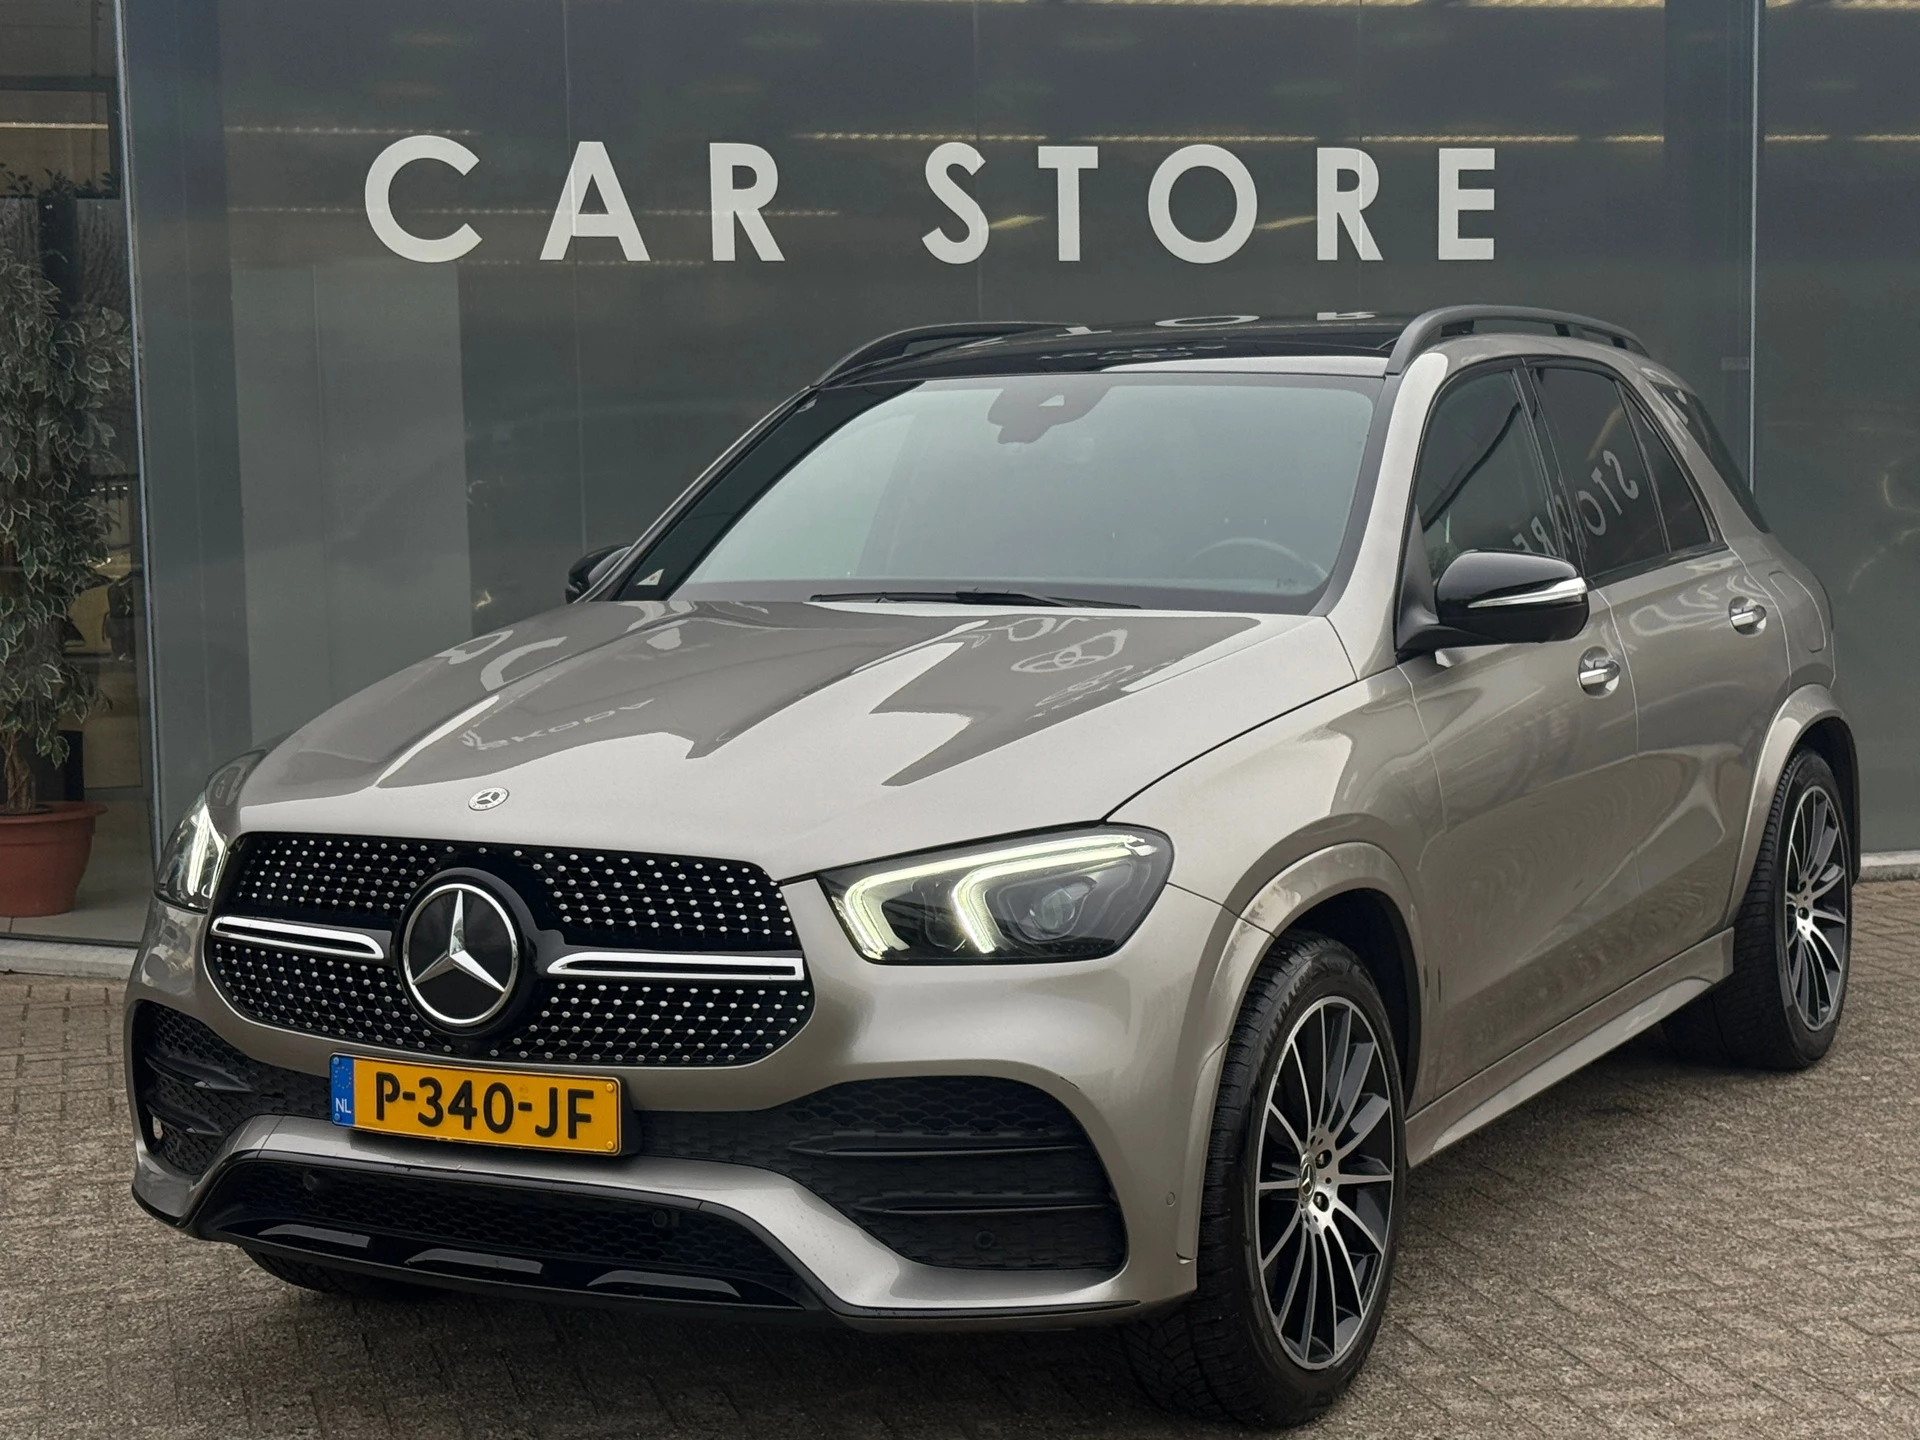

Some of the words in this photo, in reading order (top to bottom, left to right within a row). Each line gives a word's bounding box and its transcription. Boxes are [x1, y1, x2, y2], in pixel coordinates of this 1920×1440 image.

[364, 134, 785, 263] CAR
[921, 141, 1496, 264] STORE
[335, 1098, 352, 1114] NL
[375, 1071, 595, 1140] P-340-JF
